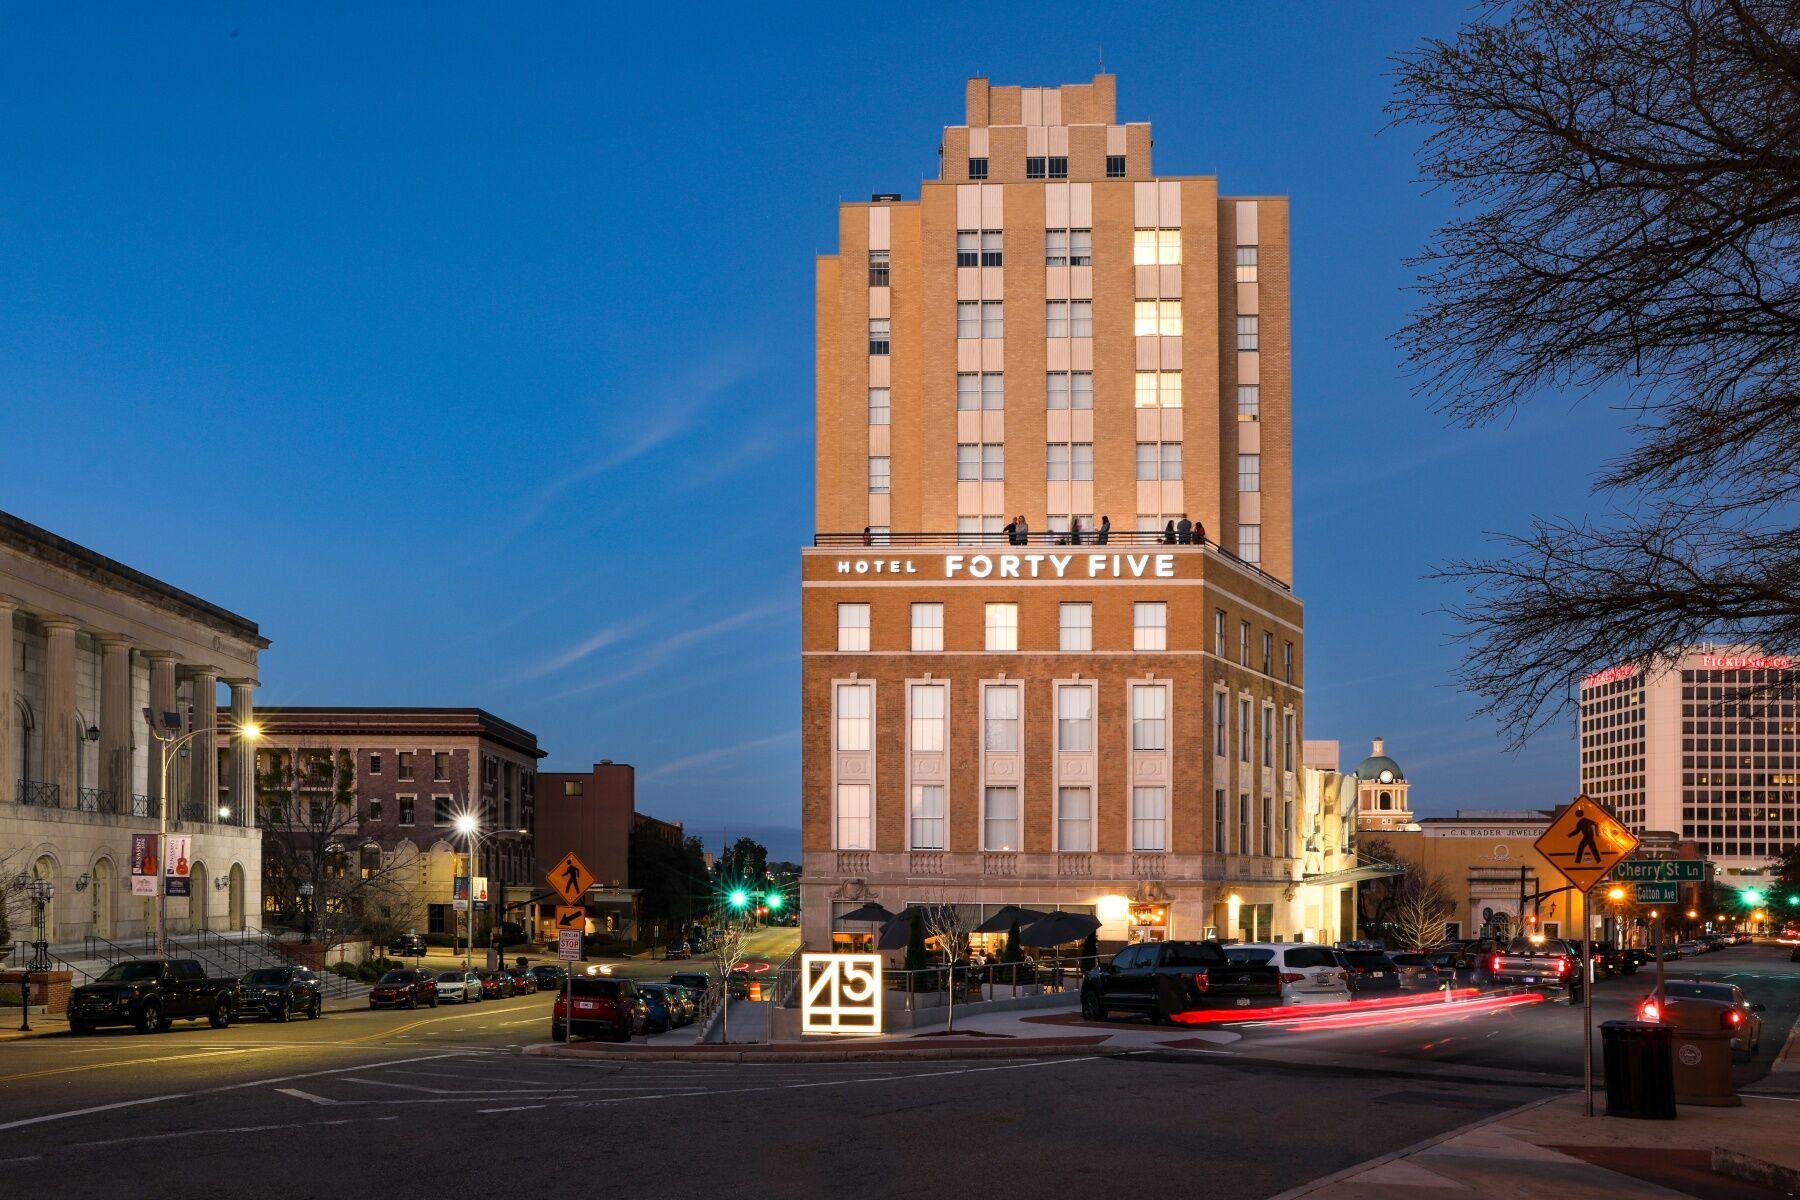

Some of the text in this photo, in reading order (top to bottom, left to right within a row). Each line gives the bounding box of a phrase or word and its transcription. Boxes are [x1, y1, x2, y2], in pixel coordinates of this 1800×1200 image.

[838, 555, 1174, 577] HOTEL FORTY FIVE
[1617, 862, 1699, 880] Cherry St Ln
[1637, 887, 1675, 900] Cotton Ave
[560, 940, 579, 948] STOP
